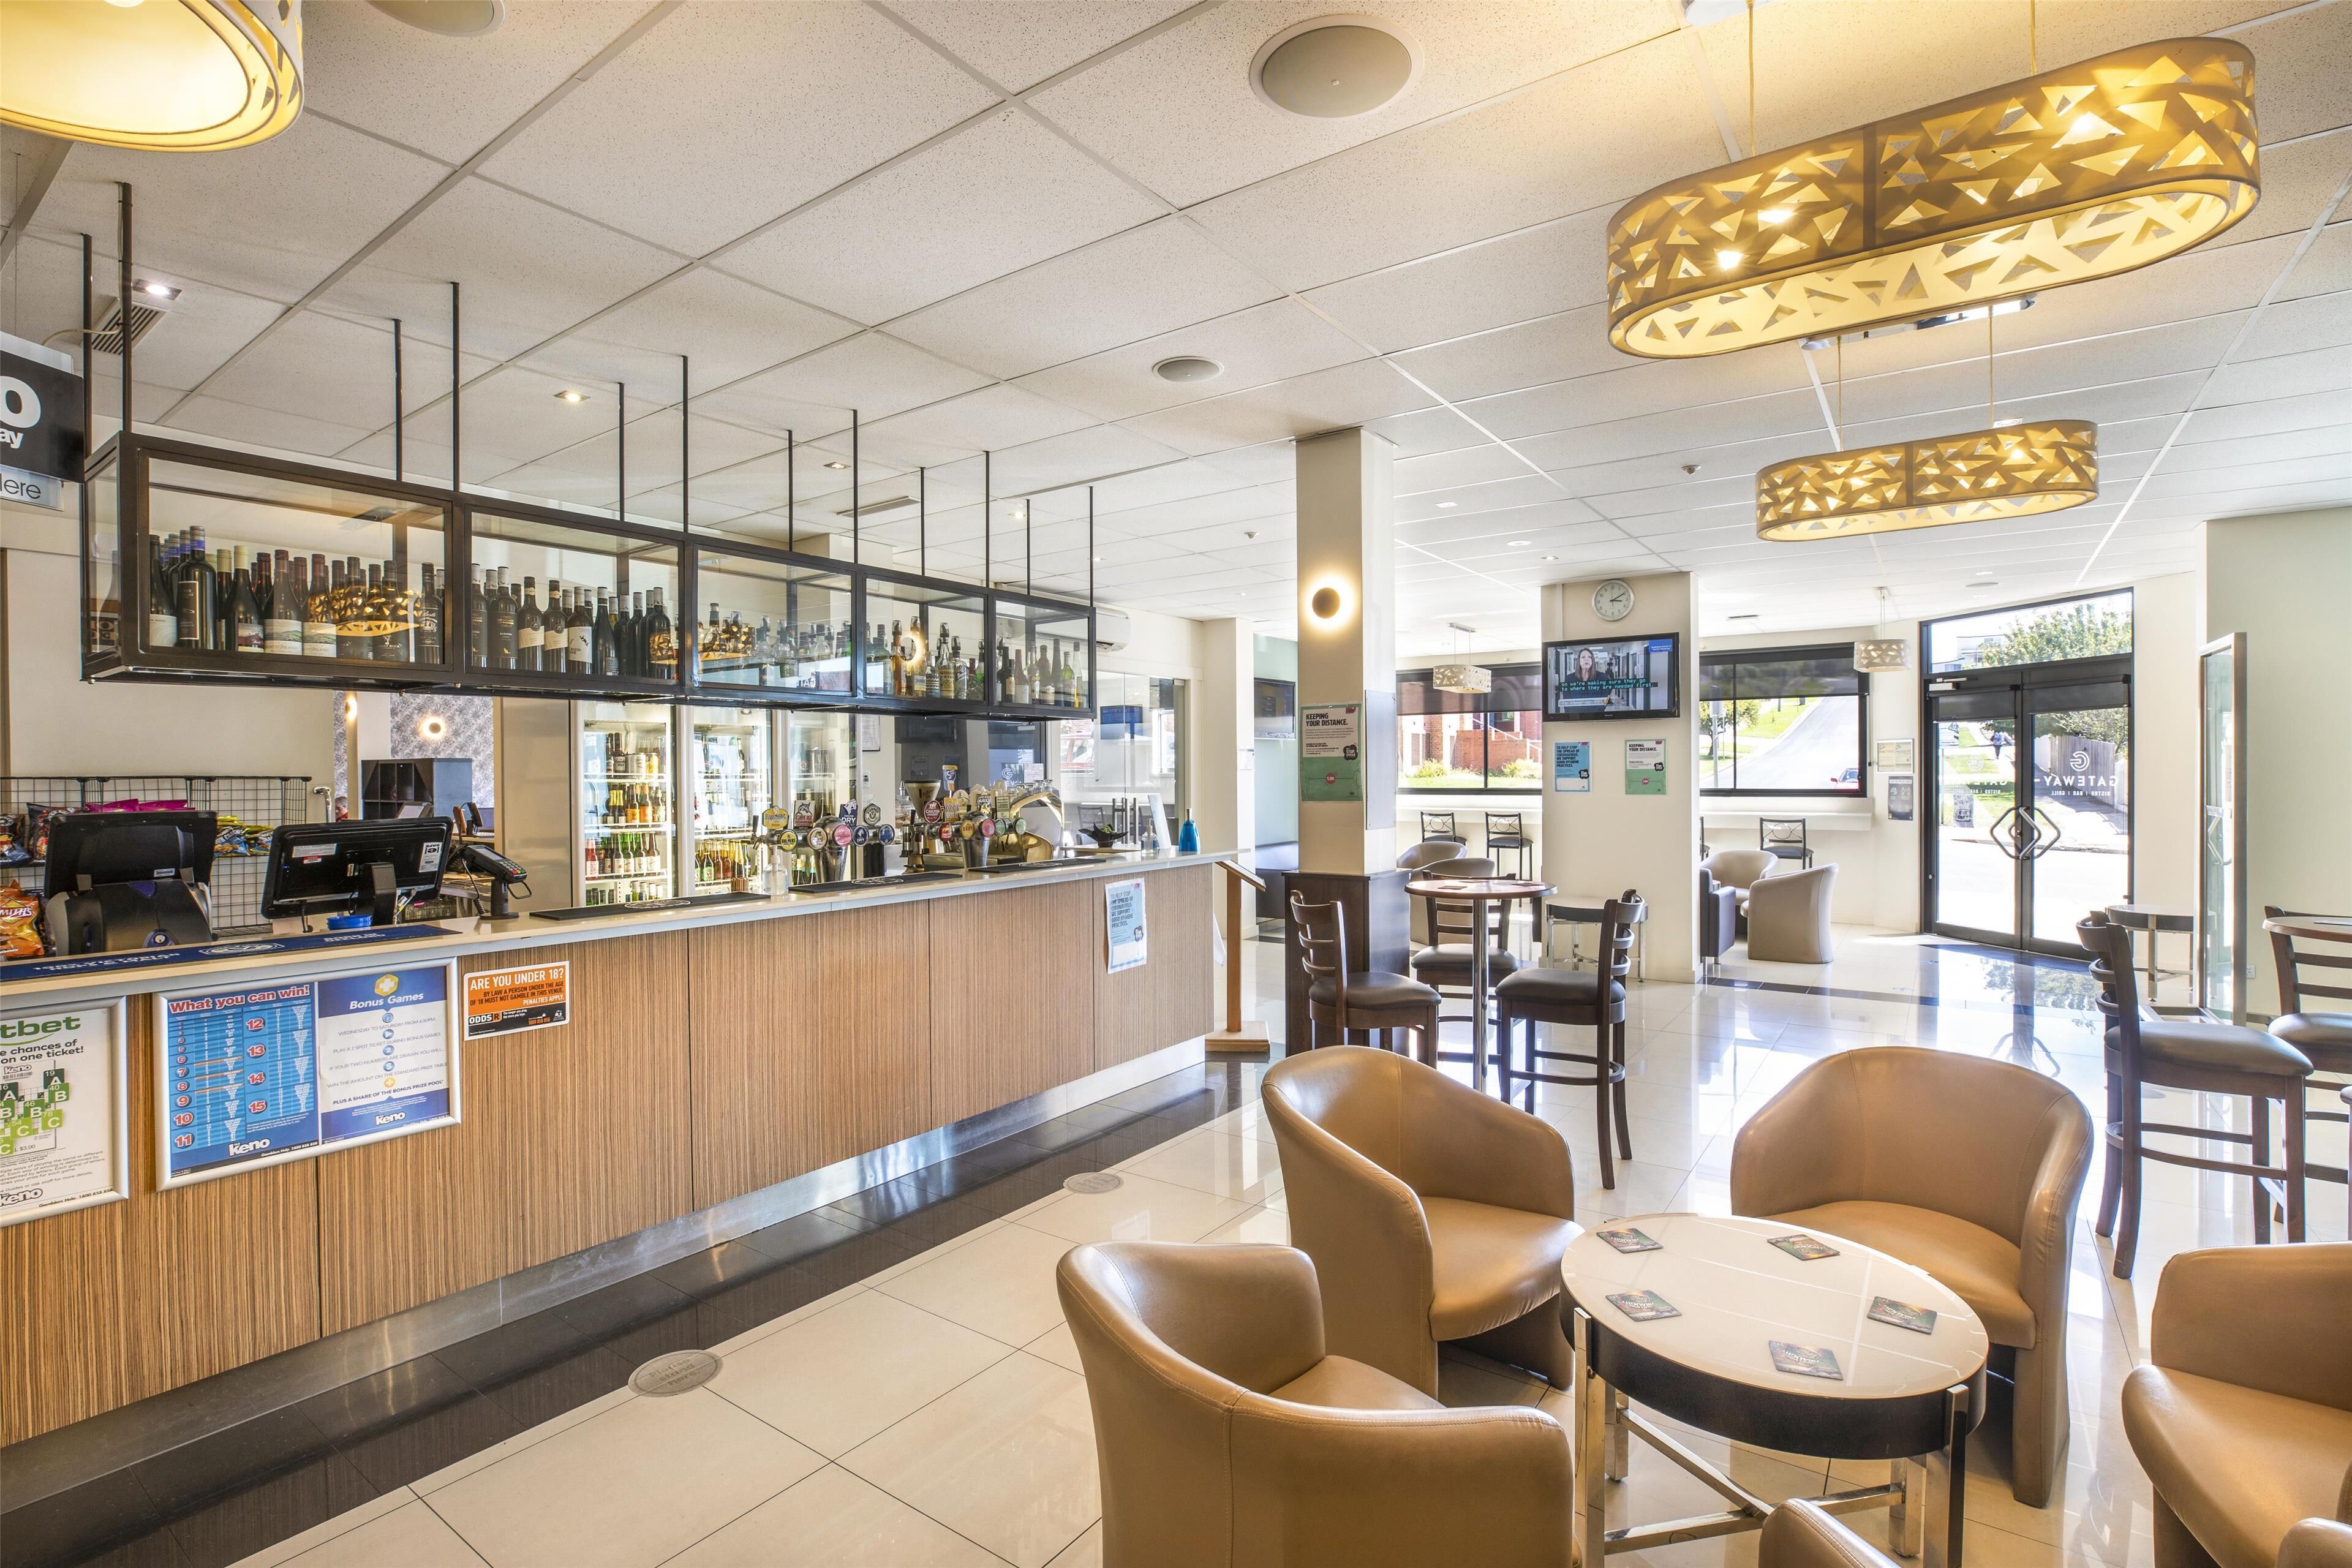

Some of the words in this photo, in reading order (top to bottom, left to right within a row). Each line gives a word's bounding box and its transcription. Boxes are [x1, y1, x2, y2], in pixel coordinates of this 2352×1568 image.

[0, 430, 23, 449] ay
[0, 907, 32, 917] MITH'S
[470, 978, 490, 990] ARE
[493, 974, 511, 987] YOU
[514, 970, 545, 984] UNDER
[549, 968, 564, 979] 18?
[169, 998, 213, 1014] What
[215, 995, 246, 1010] you
[247, 991, 277, 1003] can
[277, 984, 310, 999] win!
[350, 998, 384, 1010] Bonus
[388, 992, 424, 1005] Games
[523, 997, 548, 1005] PENALTIES
[246, 1018, 265, 1030] 12
[469, 1014, 492, 1024] ODDS
[0, 1017, 81, 1038] tbet
[338, 1027, 370, 1036] WEDNESDAY
[379, 1021, 404, 1030] SATURDAY
[10, 1042, 61, 1054] chances
[65, 1039, 78, 1047] of
[47, 1046, 83, 1058] ticket!
[247, 1044, 265, 1057] 13
[363, 1057, 389, 1065] NUMBERS
[4, 1065, 32, 1074] keno
[176, 1067, 186, 1077] 7
[350, 1075, 374, 1084] AMOUNT
[394, 1067, 420, 1076] STANDARD
[247, 1072, 265, 1085] 14
[177, 1082, 187, 1090] 8
[393, 1085, 412, 1094] BONUS
[3, 1090, 17, 1101] A
[55, 1091, 67, 1101] B
[176, 1095, 189, 1107] 9
[31, 1107, 42, 1117] B
[249, 1100, 266, 1112] 15
[1, 1107, 12, 1118] B
[375, 1111, 407, 1126] keno
[48, 1117, 60, 1128] C
[174, 1112, 194, 1126] 10
[17, 1125, 29, 1136] C
[175, 1134, 192, 1148] 11
[228, 1139, 271, 1156] keno
[39, 1199, 63, 1208] Gamblers
[650, 1358, 690, 1378] Please
[659, 1363, 696, 1381] stand
[667, 1371, 701, 1385] here.
